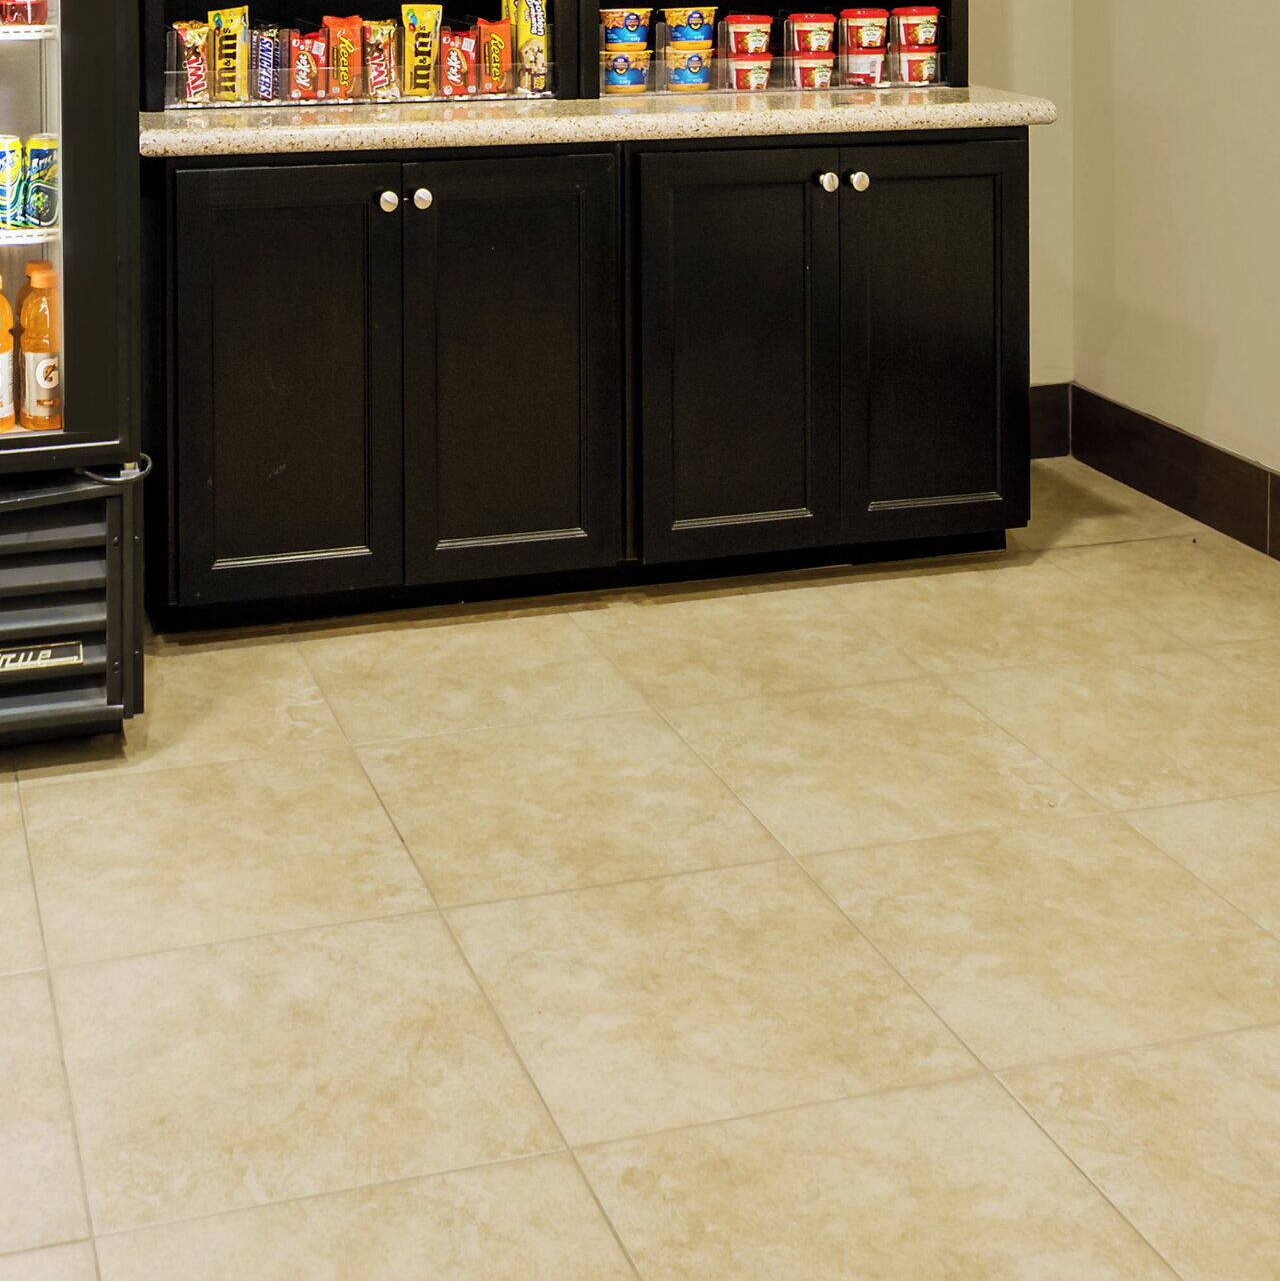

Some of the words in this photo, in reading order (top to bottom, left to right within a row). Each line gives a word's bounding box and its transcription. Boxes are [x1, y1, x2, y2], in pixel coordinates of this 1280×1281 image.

[258, 35, 274, 100] SNICKERS
[338, 34, 355, 87] Reese's
[490, 32, 506, 83] Reese's
